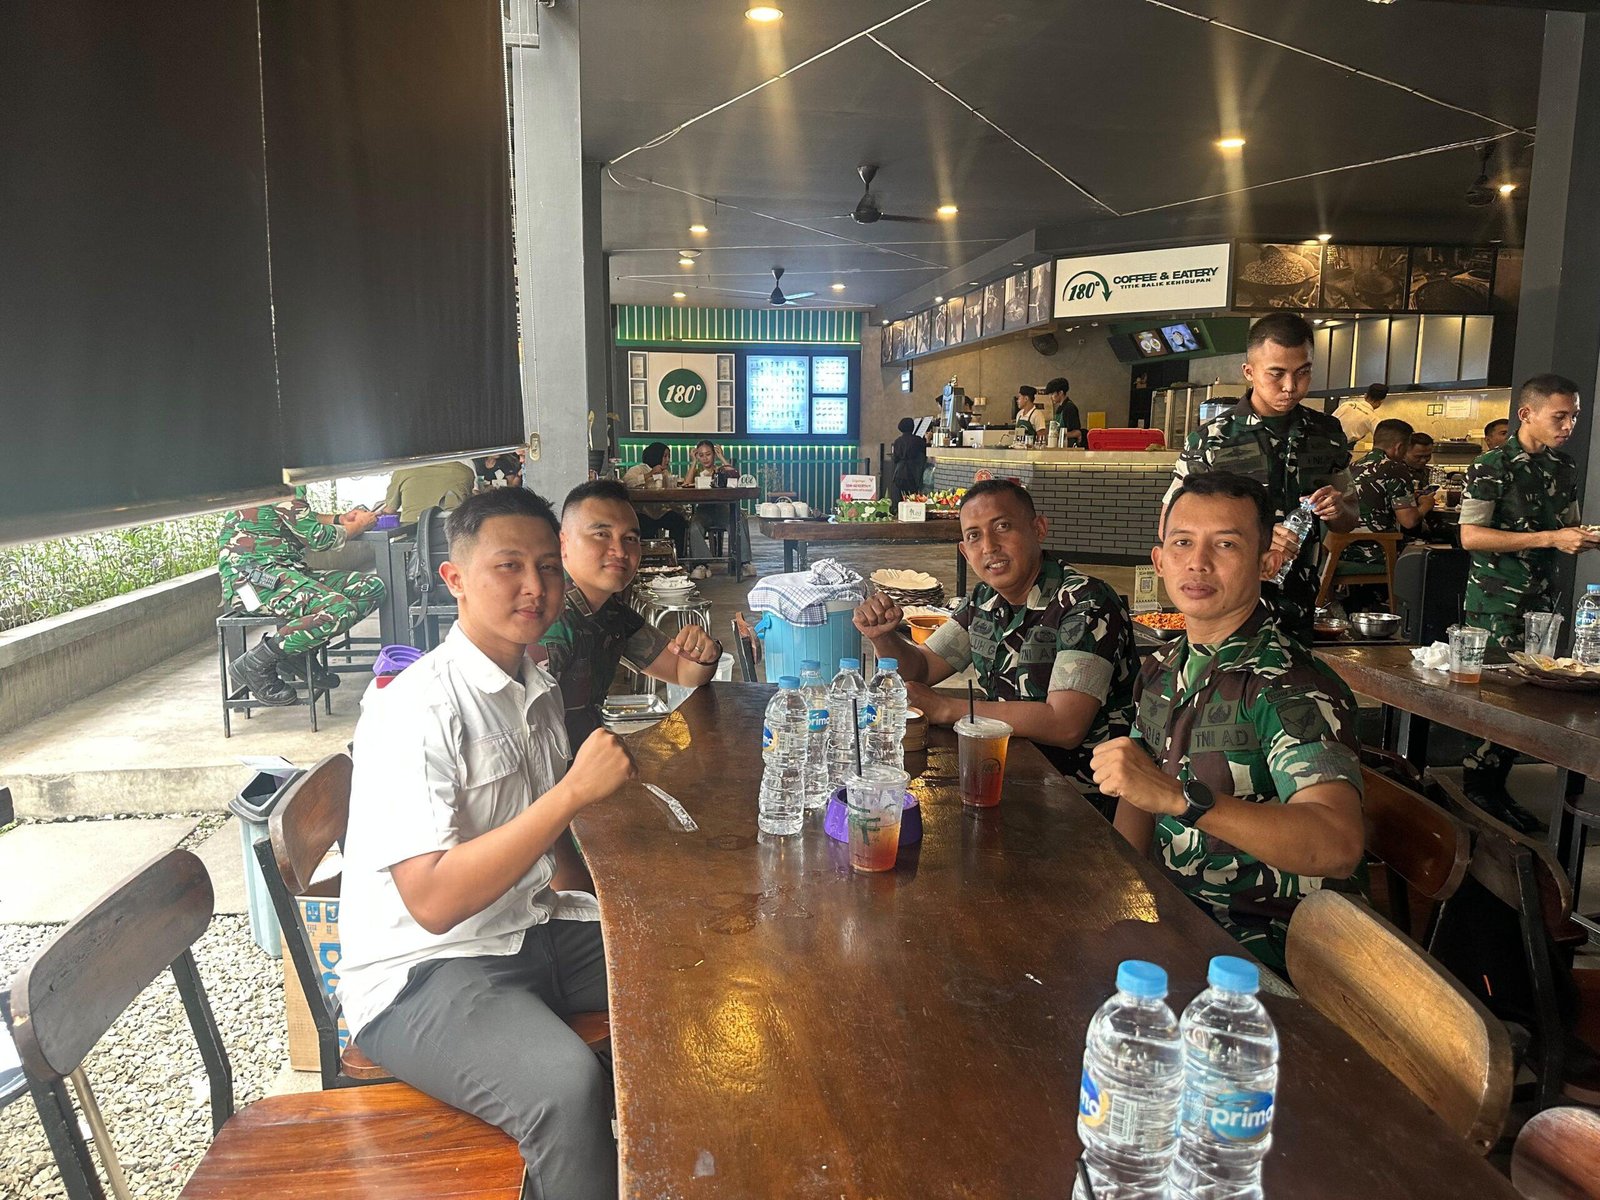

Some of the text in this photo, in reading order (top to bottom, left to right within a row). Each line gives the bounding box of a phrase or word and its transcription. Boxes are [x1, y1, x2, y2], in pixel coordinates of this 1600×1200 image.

[1113, 267, 1219, 285] COFFEE & EATERY
[1165, 278, 1211, 286] KEHIDUPAN
[1068, 281, 1100, 301] 180°
[664, 385, 702, 404] 180°
[1195, 728, 1249, 748] TNI AD
